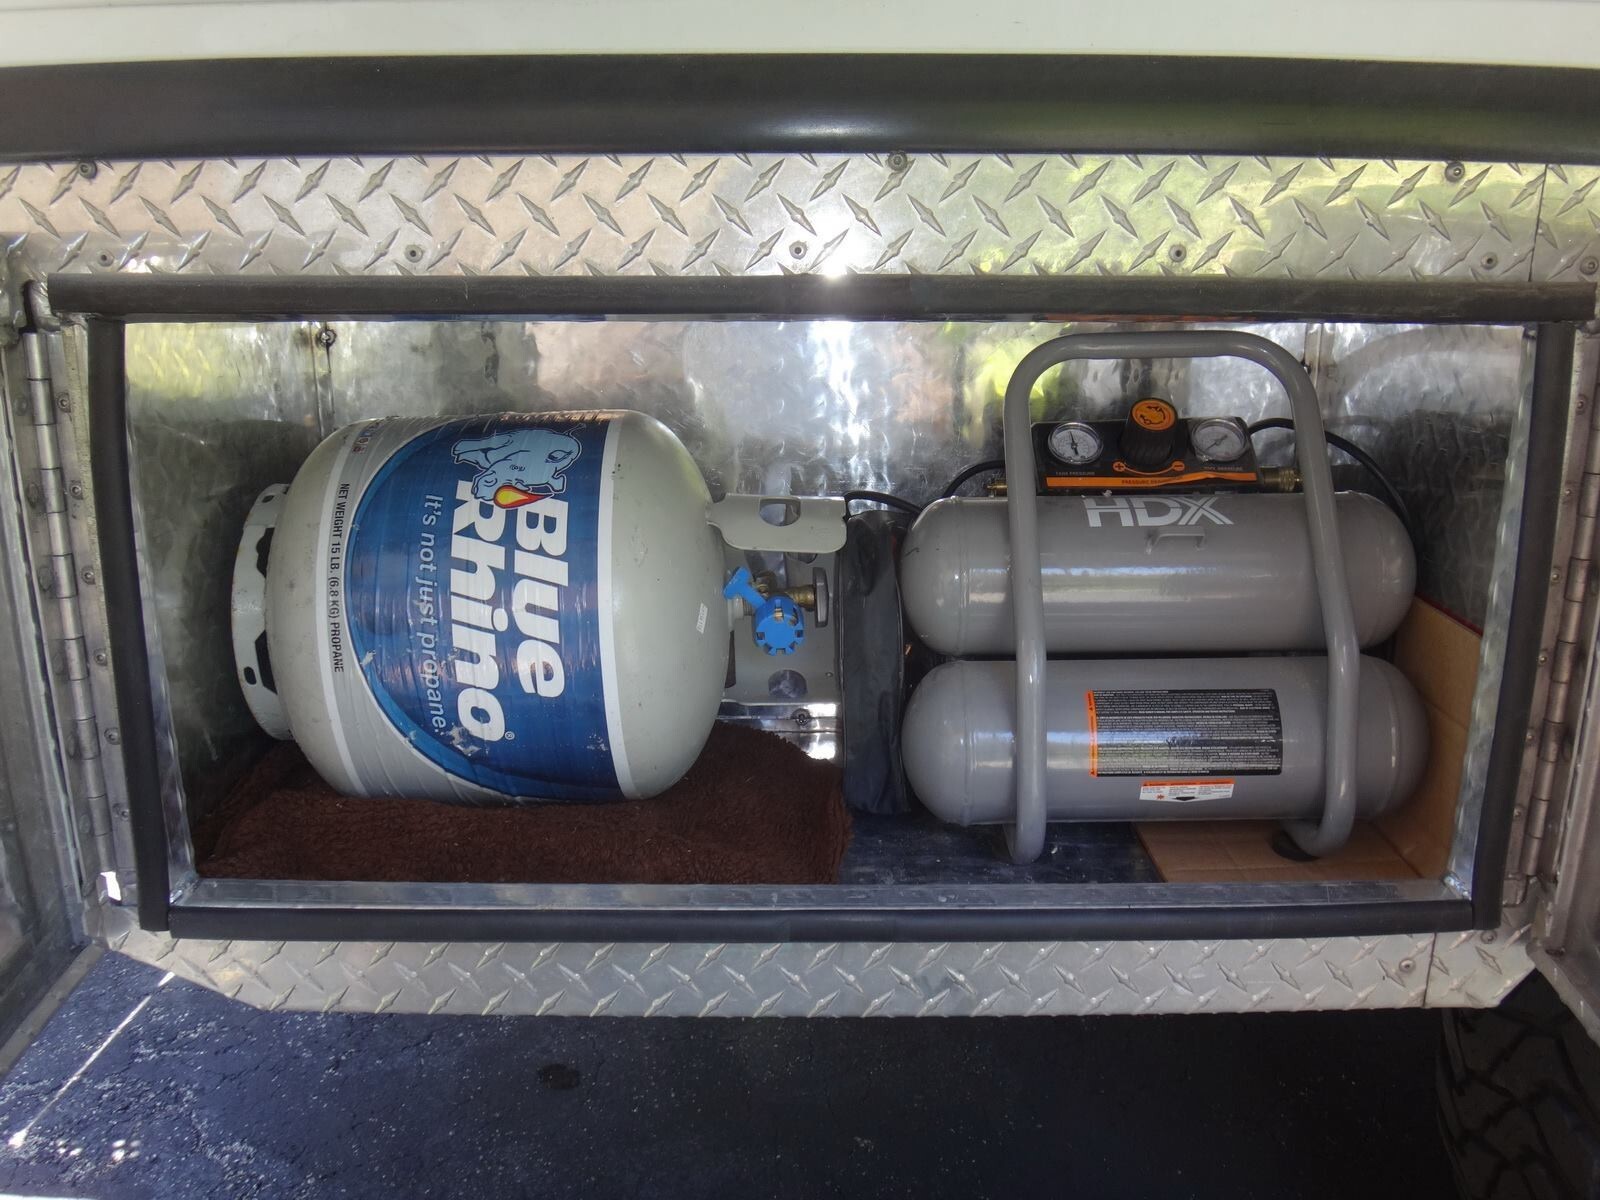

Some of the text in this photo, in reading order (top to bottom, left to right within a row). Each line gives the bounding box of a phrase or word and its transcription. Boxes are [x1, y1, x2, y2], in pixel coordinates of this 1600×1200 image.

[1083, 496, 1234, 527] HDX
[418, 532, 440, 571] not
[328, 483, 350, 673] NET WEIGHT 15 LB. (6.8 KG) PROPANE
[414, 577, 441, 625] just
[513, 498, 569, 698] Blue
